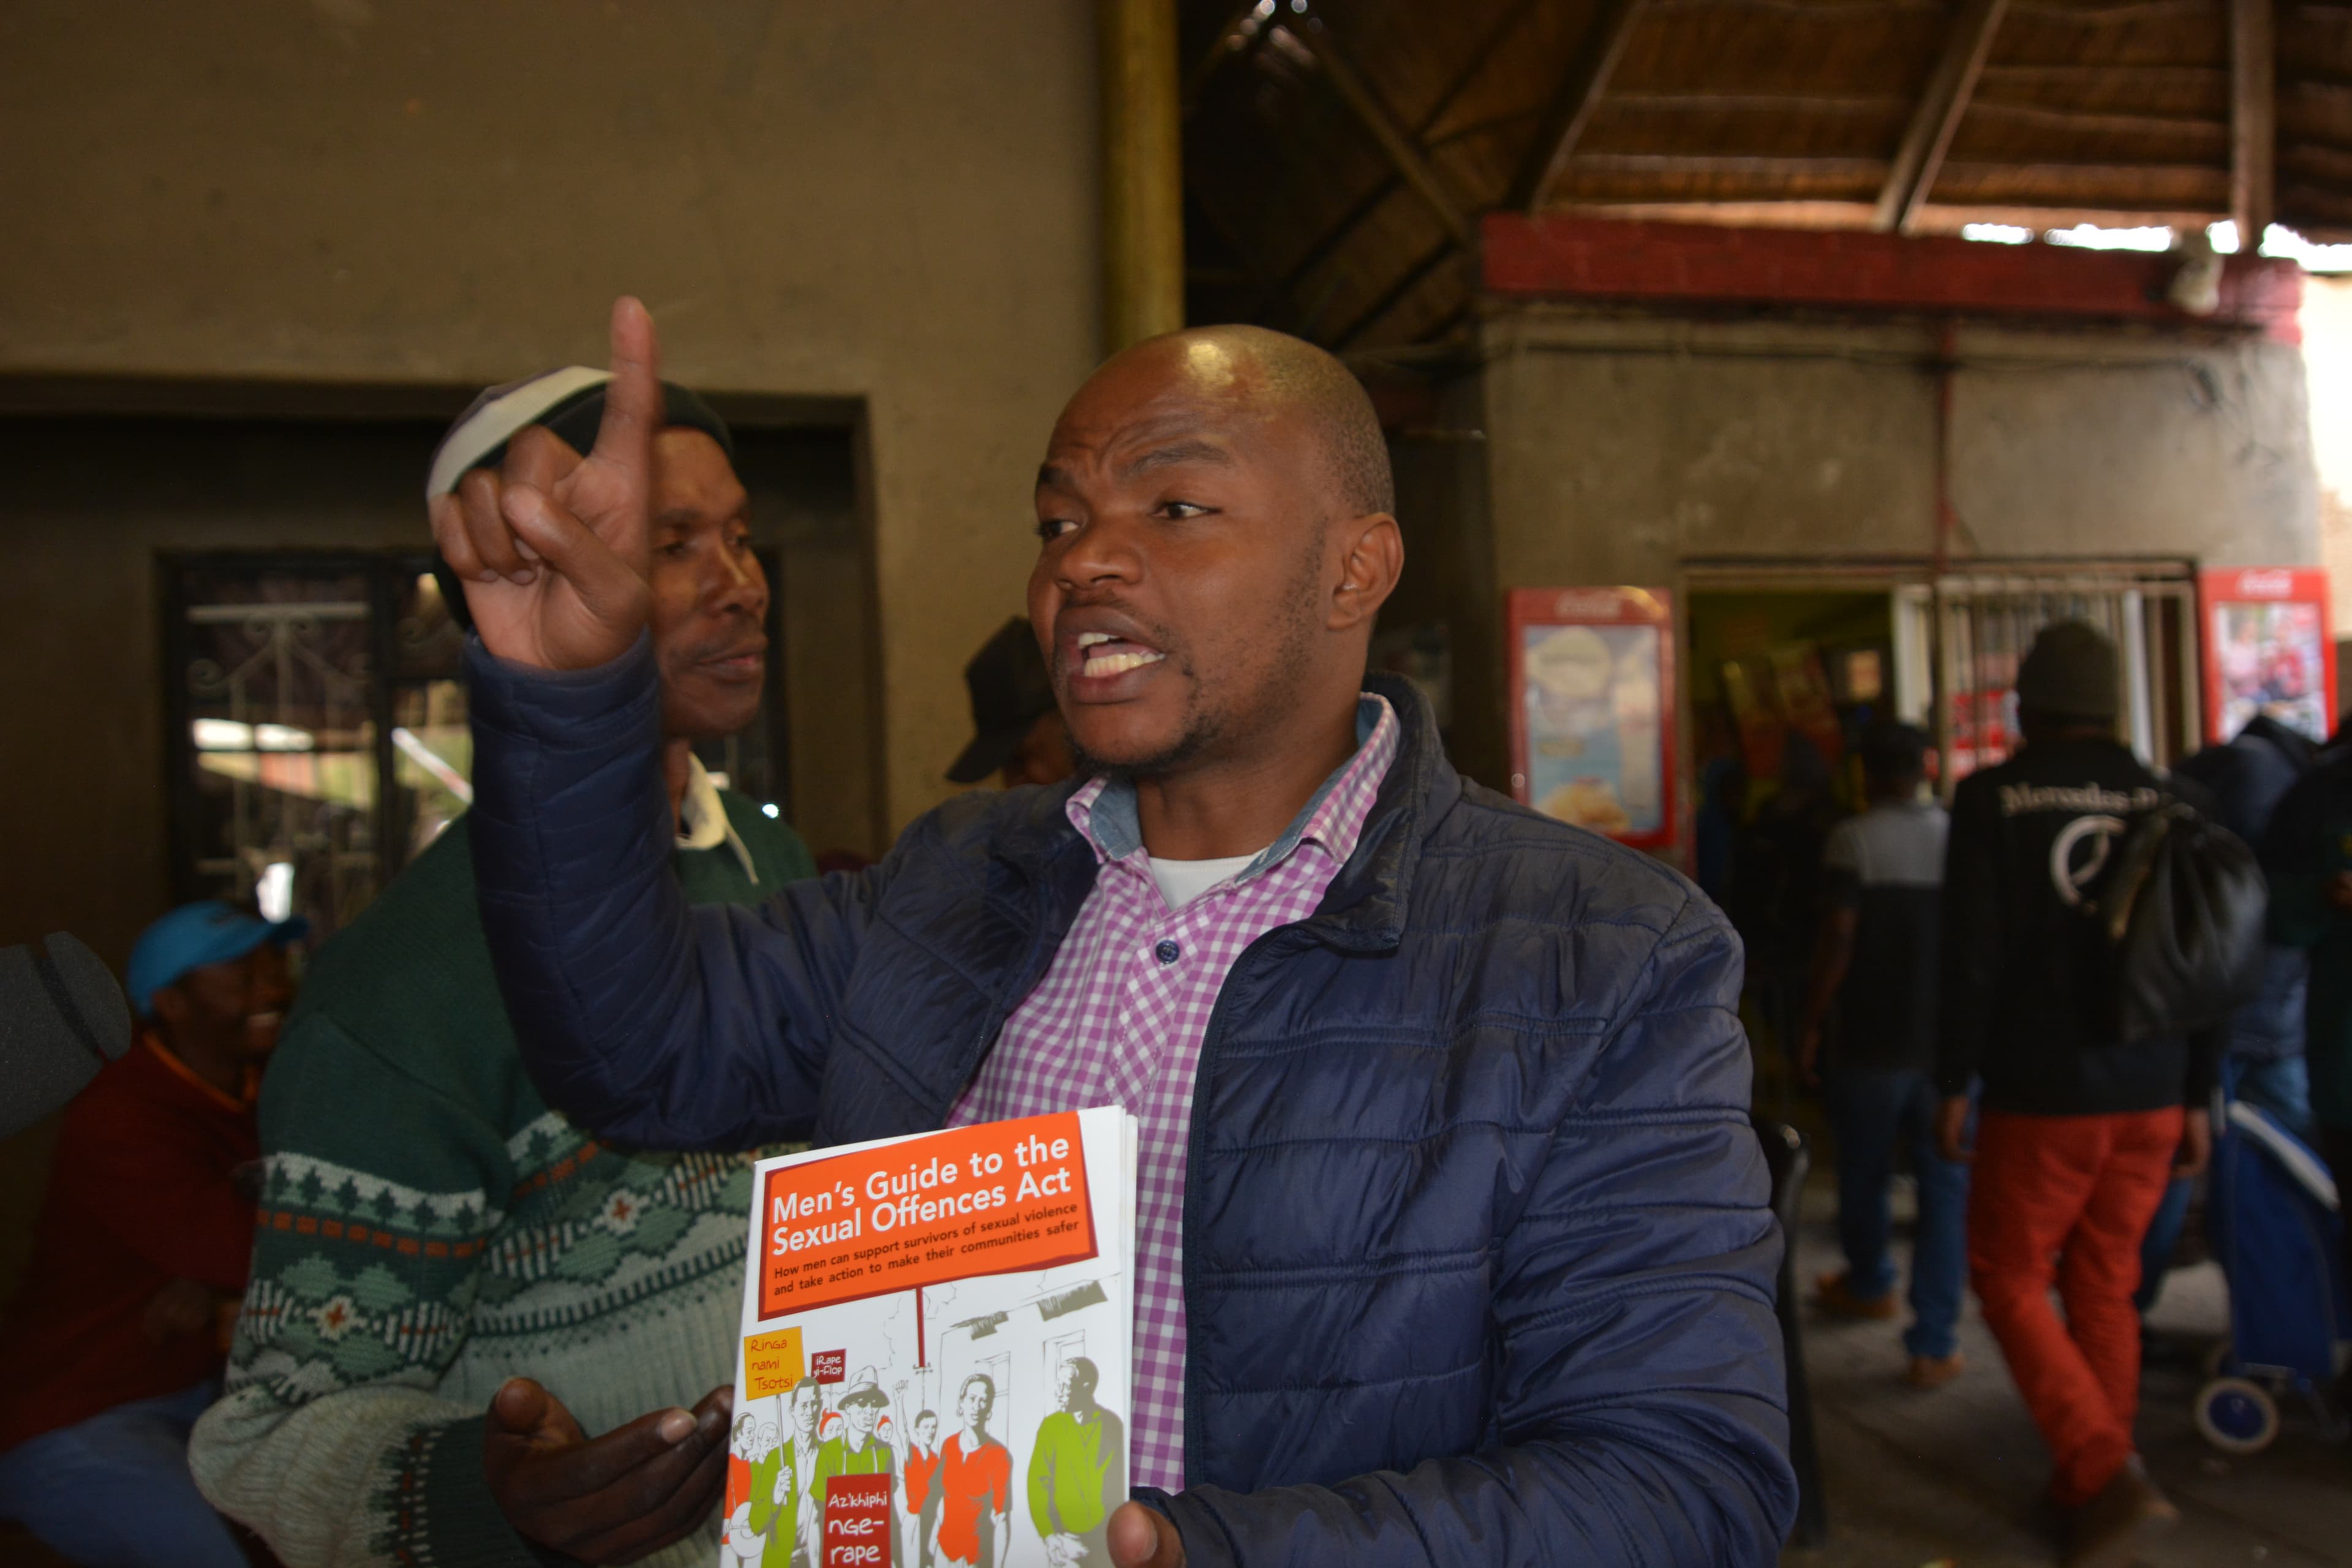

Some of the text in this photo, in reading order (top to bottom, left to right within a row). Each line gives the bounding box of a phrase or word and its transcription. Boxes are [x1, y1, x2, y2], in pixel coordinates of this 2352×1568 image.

[772, 1167, 1071, 1256] Sexual Offences Act
[773, 1134, 1069, 1224] Men's Guide to the
[774, 1220, 1079, 1295] and take action to make their communities safer
[775, 1204, 1078, 1279] How men can support survivors of sexual violence
[755, 1374, 794, 1390] Tsotsi
[830, 1545, 881, 1566] rape
